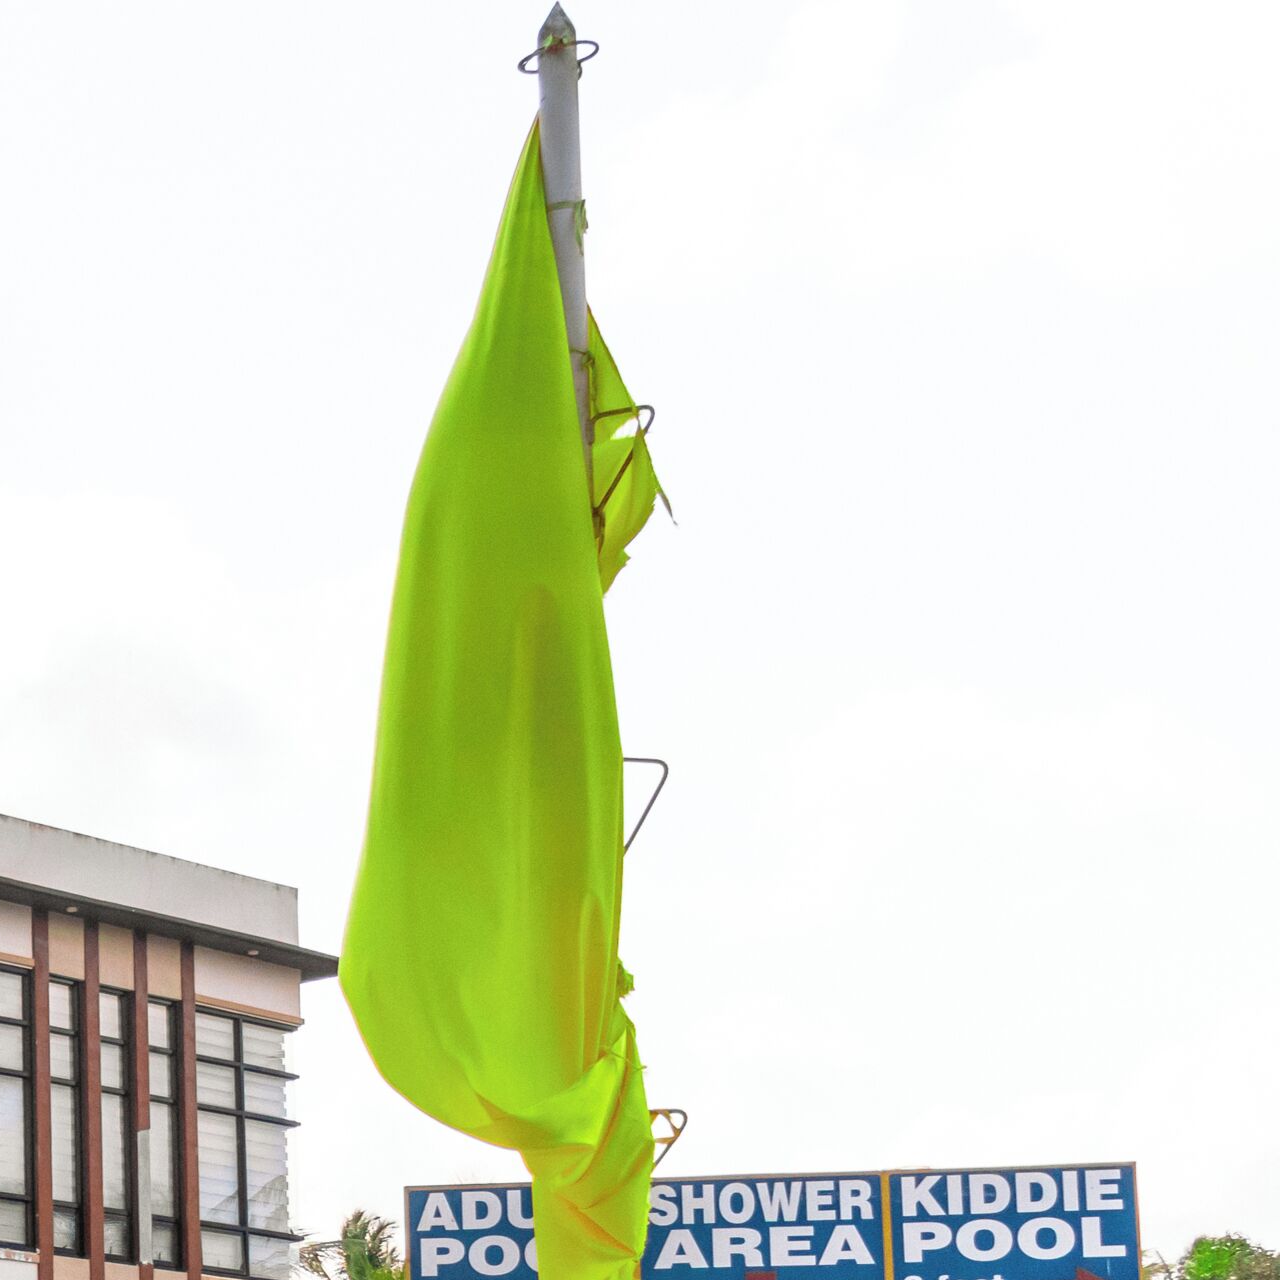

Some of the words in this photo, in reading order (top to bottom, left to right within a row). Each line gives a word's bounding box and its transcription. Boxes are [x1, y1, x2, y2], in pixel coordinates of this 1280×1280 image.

[416, 1189, 535, 1232] ADU
[648, 1179, 874, 1226] SHOWER
[900, 1168, 1124, 1217] KIDDIE
[419, 1234, 539, 1277] PO
[653, 1224, 876, 1269] AREA
[902, 1216, 1127, 1263] POOL
